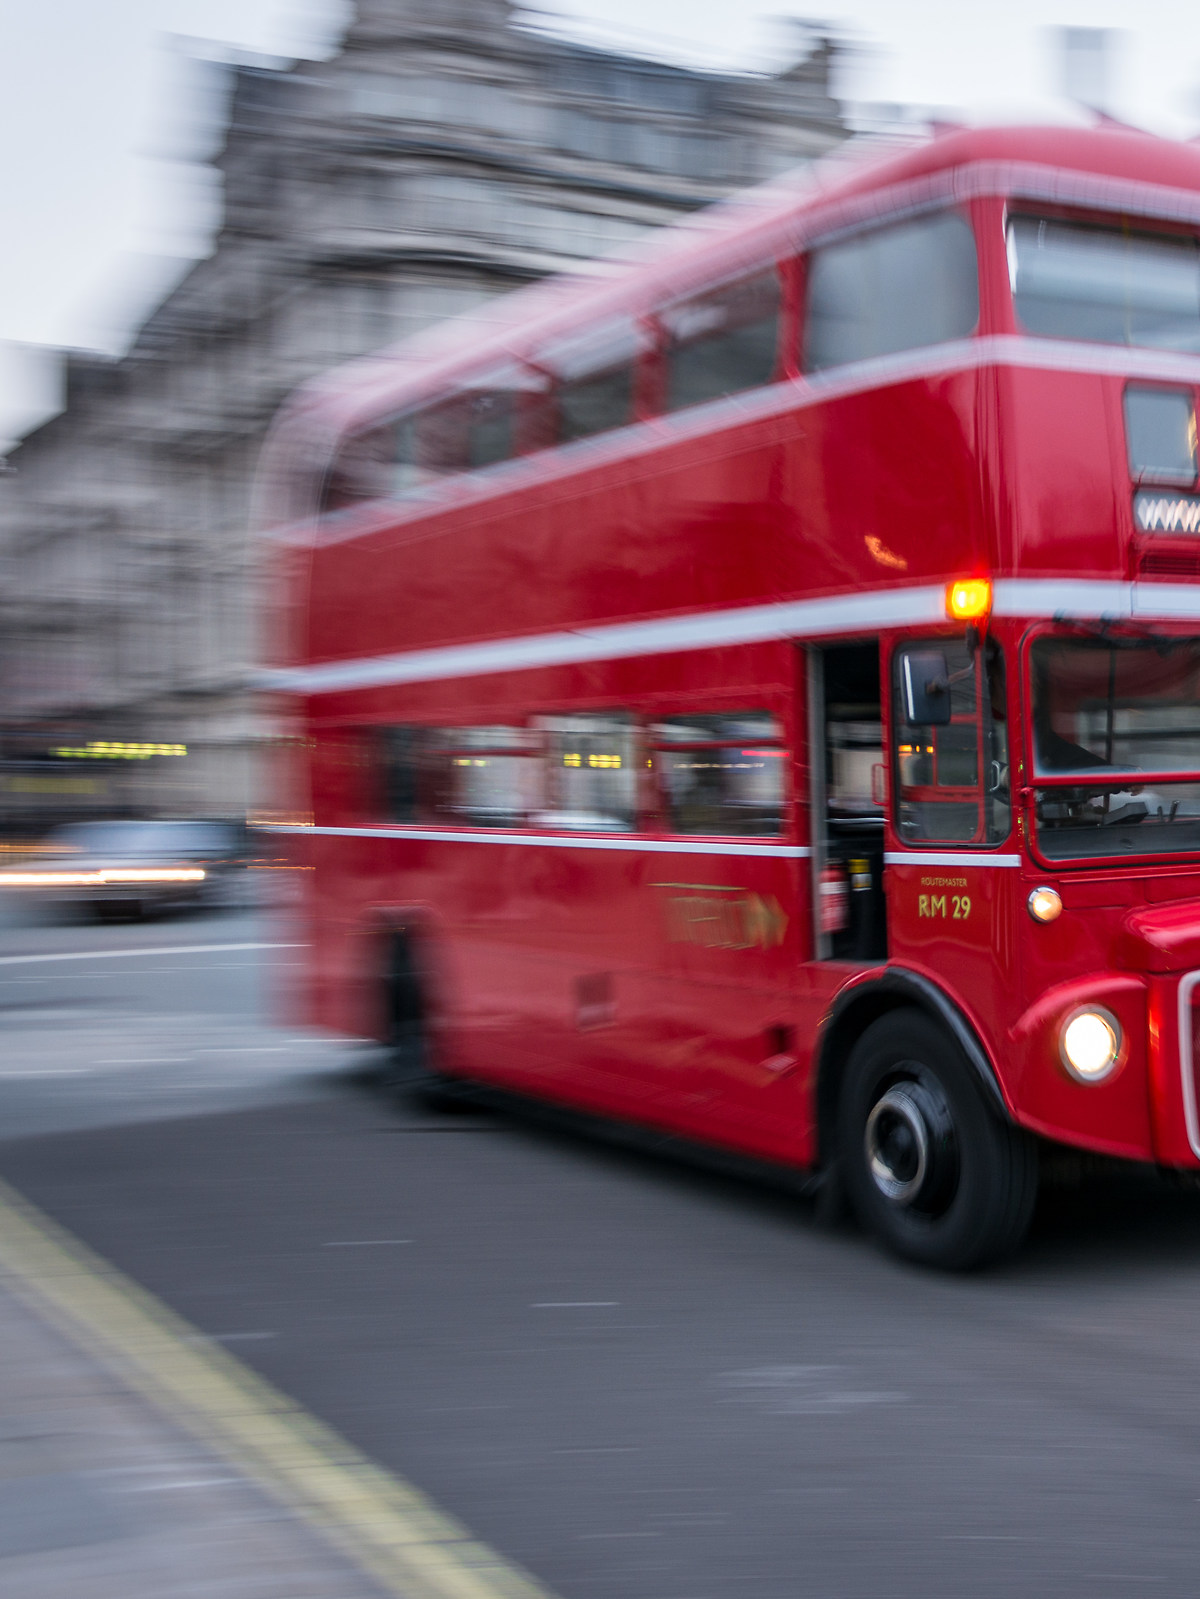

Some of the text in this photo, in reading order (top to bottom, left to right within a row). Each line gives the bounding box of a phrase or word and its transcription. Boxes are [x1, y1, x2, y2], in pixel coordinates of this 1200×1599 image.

[921, 877, 967, 887] ROUTEMASTER
[918, 894, 972, 919] RM 29
